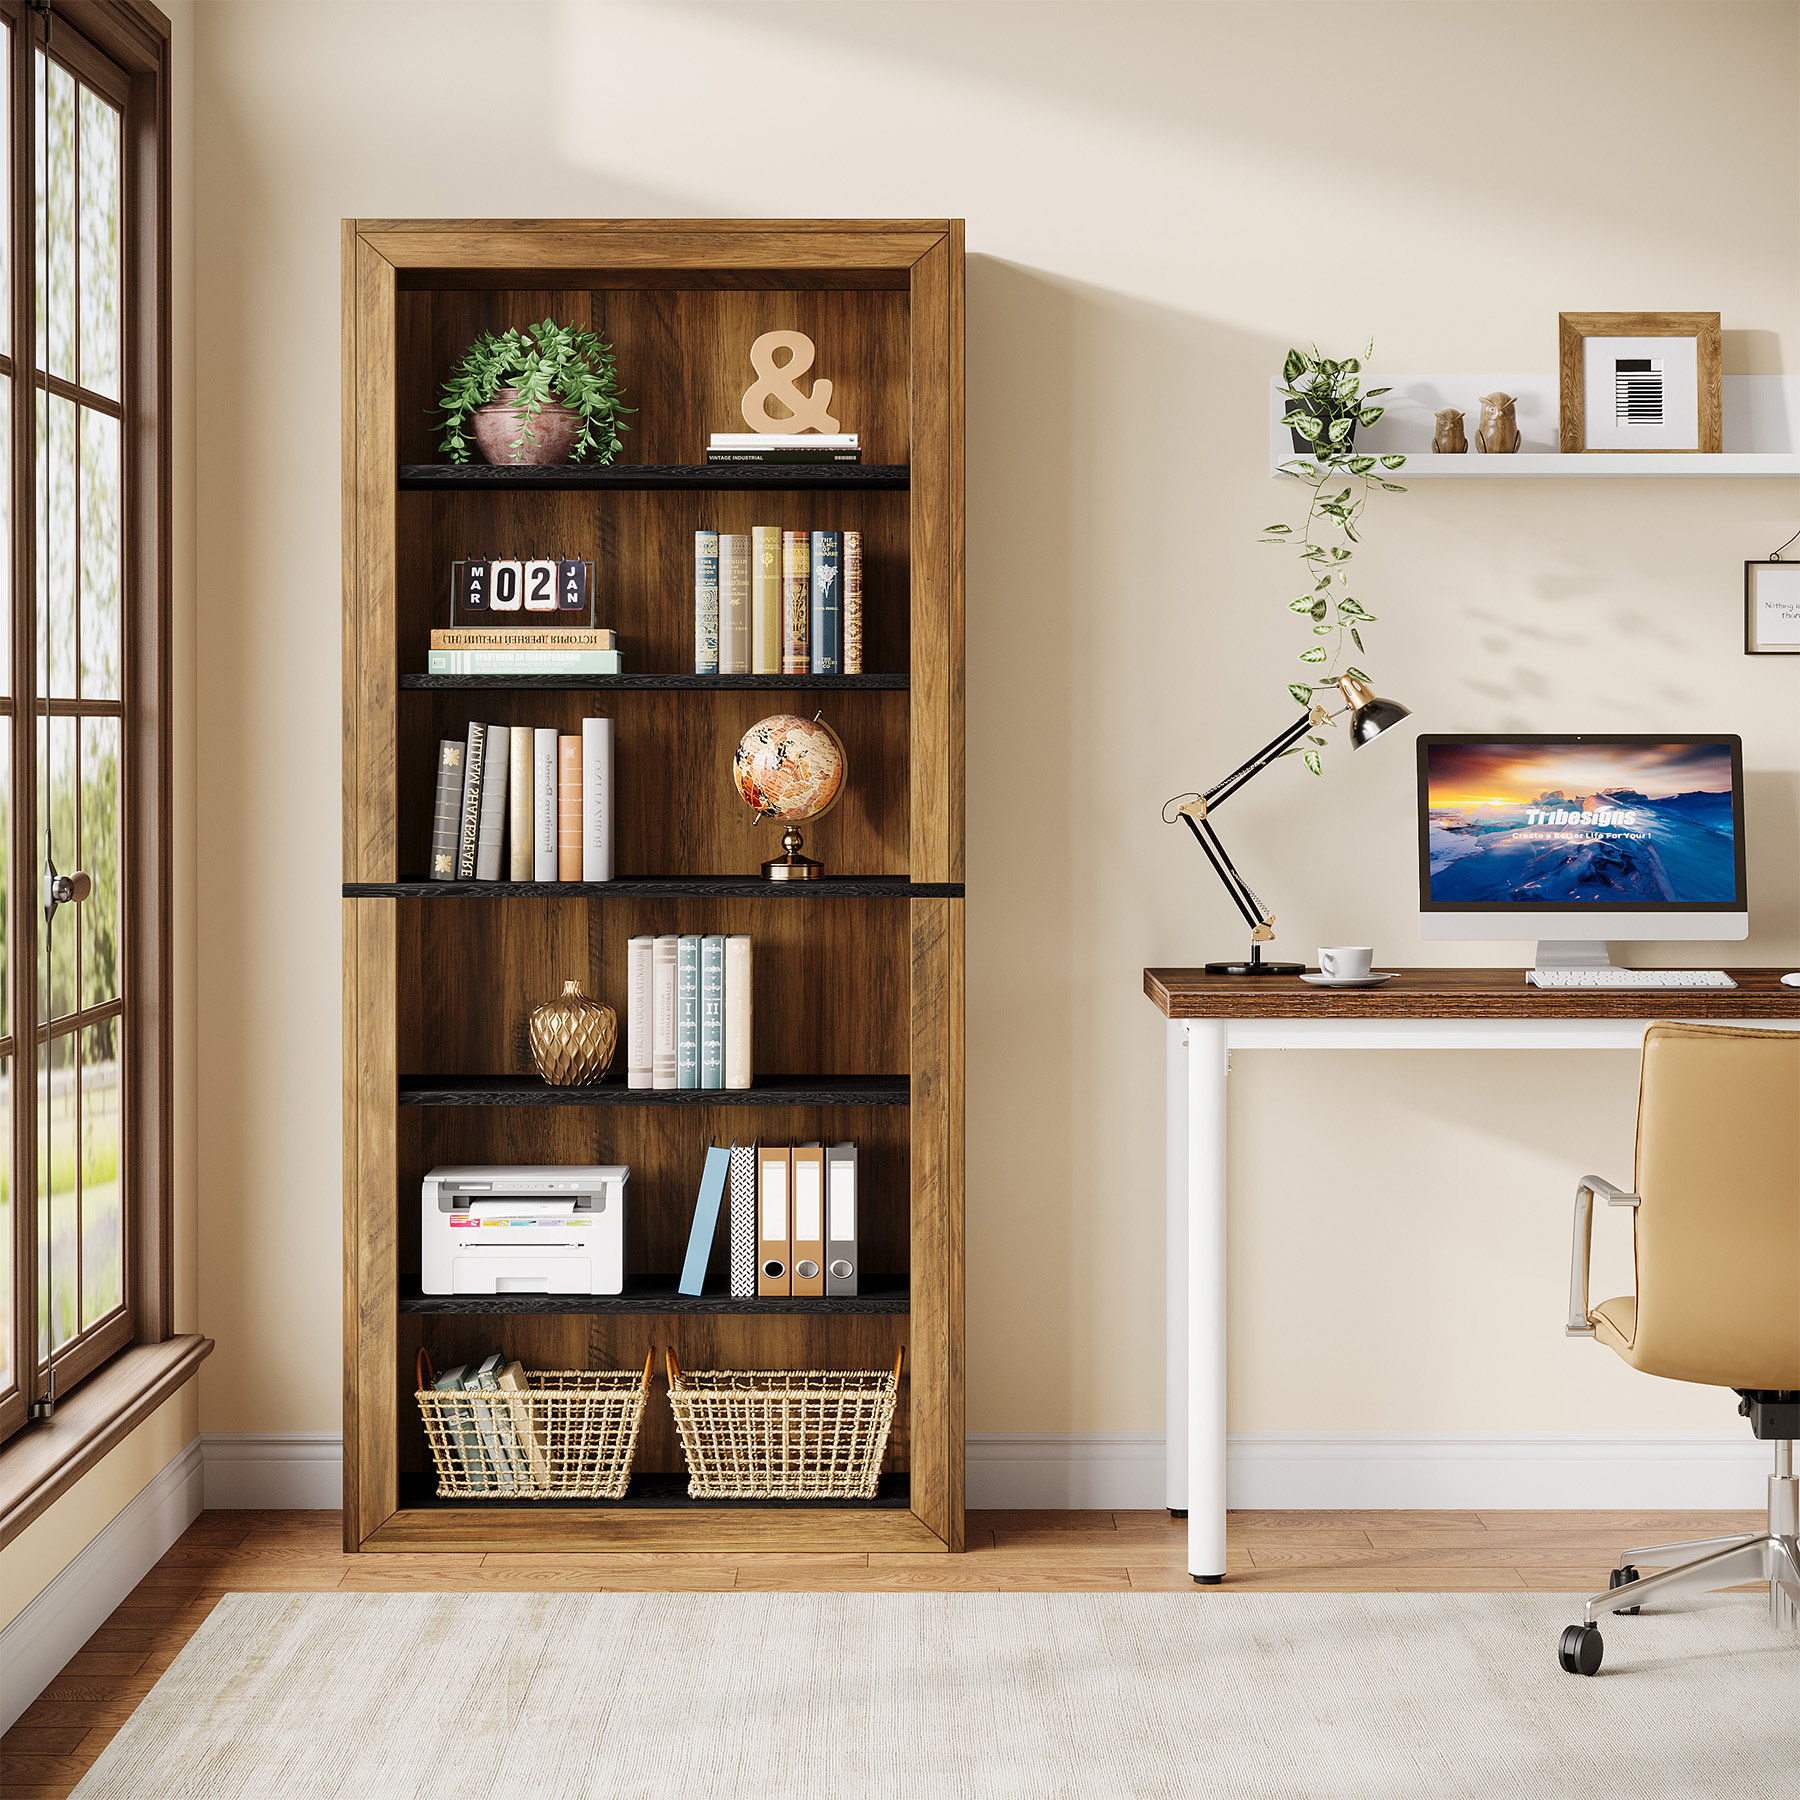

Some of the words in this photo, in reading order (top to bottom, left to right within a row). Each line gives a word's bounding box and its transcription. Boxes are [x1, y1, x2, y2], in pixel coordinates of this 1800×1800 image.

[469, 566, 484, 604] MAR
[566, 566, 578, 603] JAN
[1765, 602, 1794, 612] Nothing
[464, 635, 502, 644] ГРЕЦИИ
[504, 635, 549, 646] ДРЕВНЕЙ
[550, 635, 598, 644] ИСТОРИЯ
[1525, 806, 1636, 827] Tribesigns
[685, 1002, 692, 1015] I
[706, 1002, 719, 1015] II
